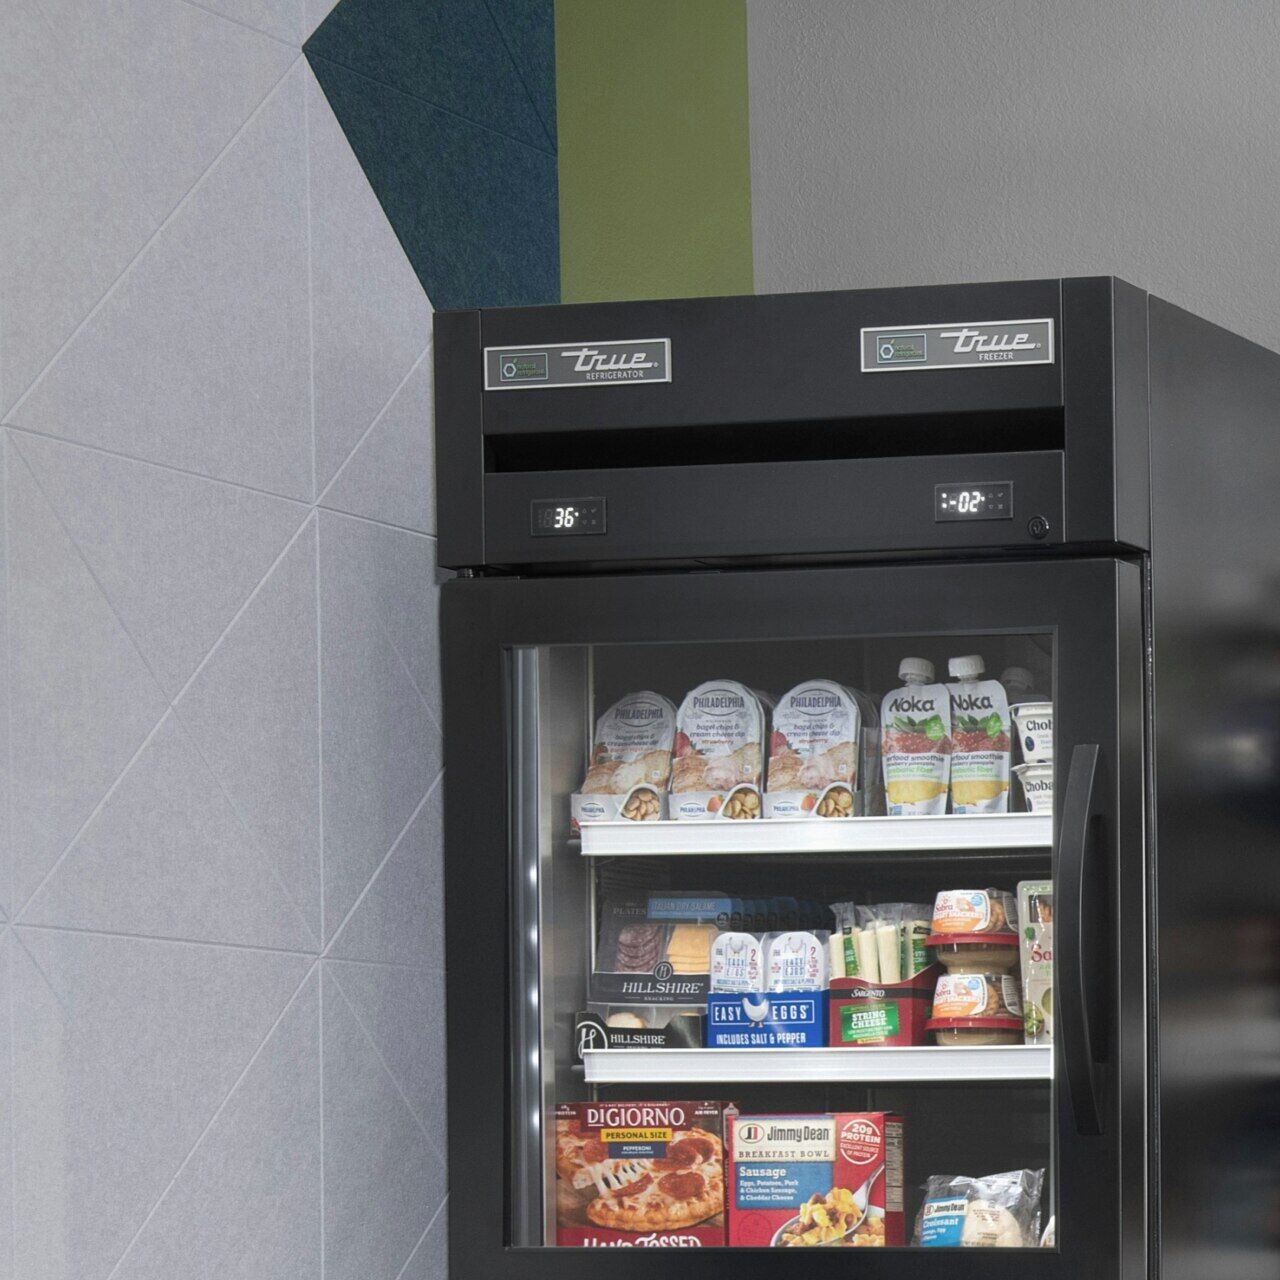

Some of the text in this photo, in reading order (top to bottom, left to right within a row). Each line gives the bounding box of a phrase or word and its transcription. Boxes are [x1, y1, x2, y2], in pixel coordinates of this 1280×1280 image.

[586, 371, 643, 380] REFRIGERATOR
[555, 508, 573, 527] 36
[622, 983, 699, 994] HILLSHIRE
[713, 1005, 807, 1023] EASY EGGS
[717, 1033, 806, 1045] INCLUDES SALT & PEPPER
[606, 1131, 667, 1139] PERSONAL SIZE
[767, 1126, 829, 1144] Jimmy Dean
[740, 1166, 786, 1180] Sausage
